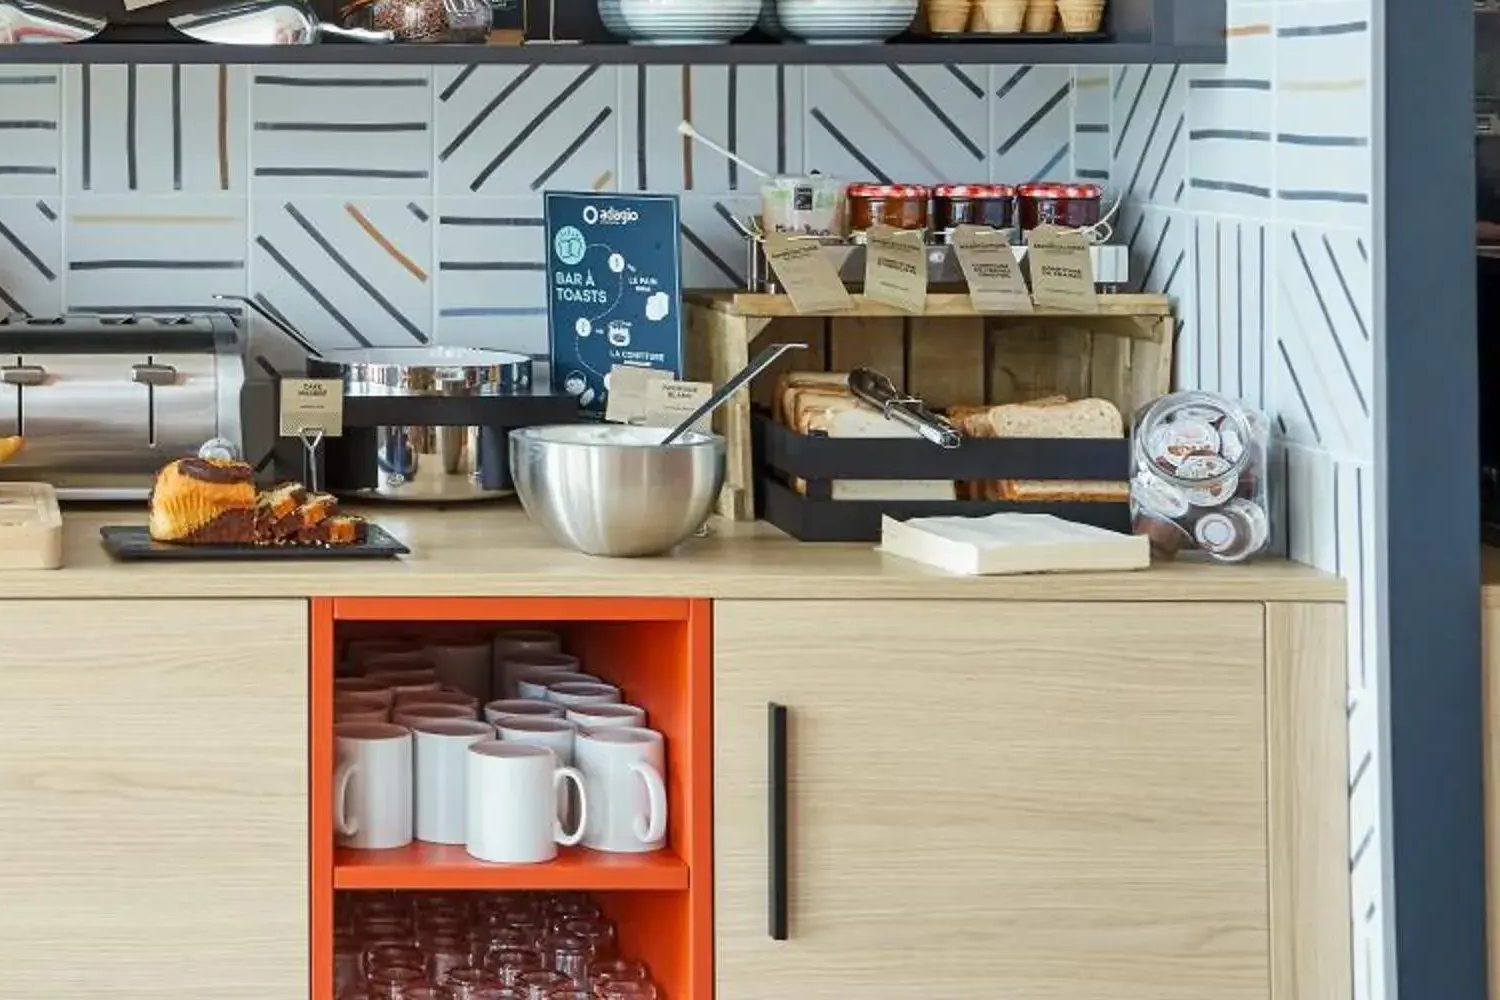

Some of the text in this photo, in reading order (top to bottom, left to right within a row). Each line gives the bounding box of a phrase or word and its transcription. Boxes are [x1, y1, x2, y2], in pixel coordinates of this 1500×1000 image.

[599, 206, 639, 225] adagio
[555, 271, 583, 285] BAR
[555, 287, 607, 303] TOASTS
